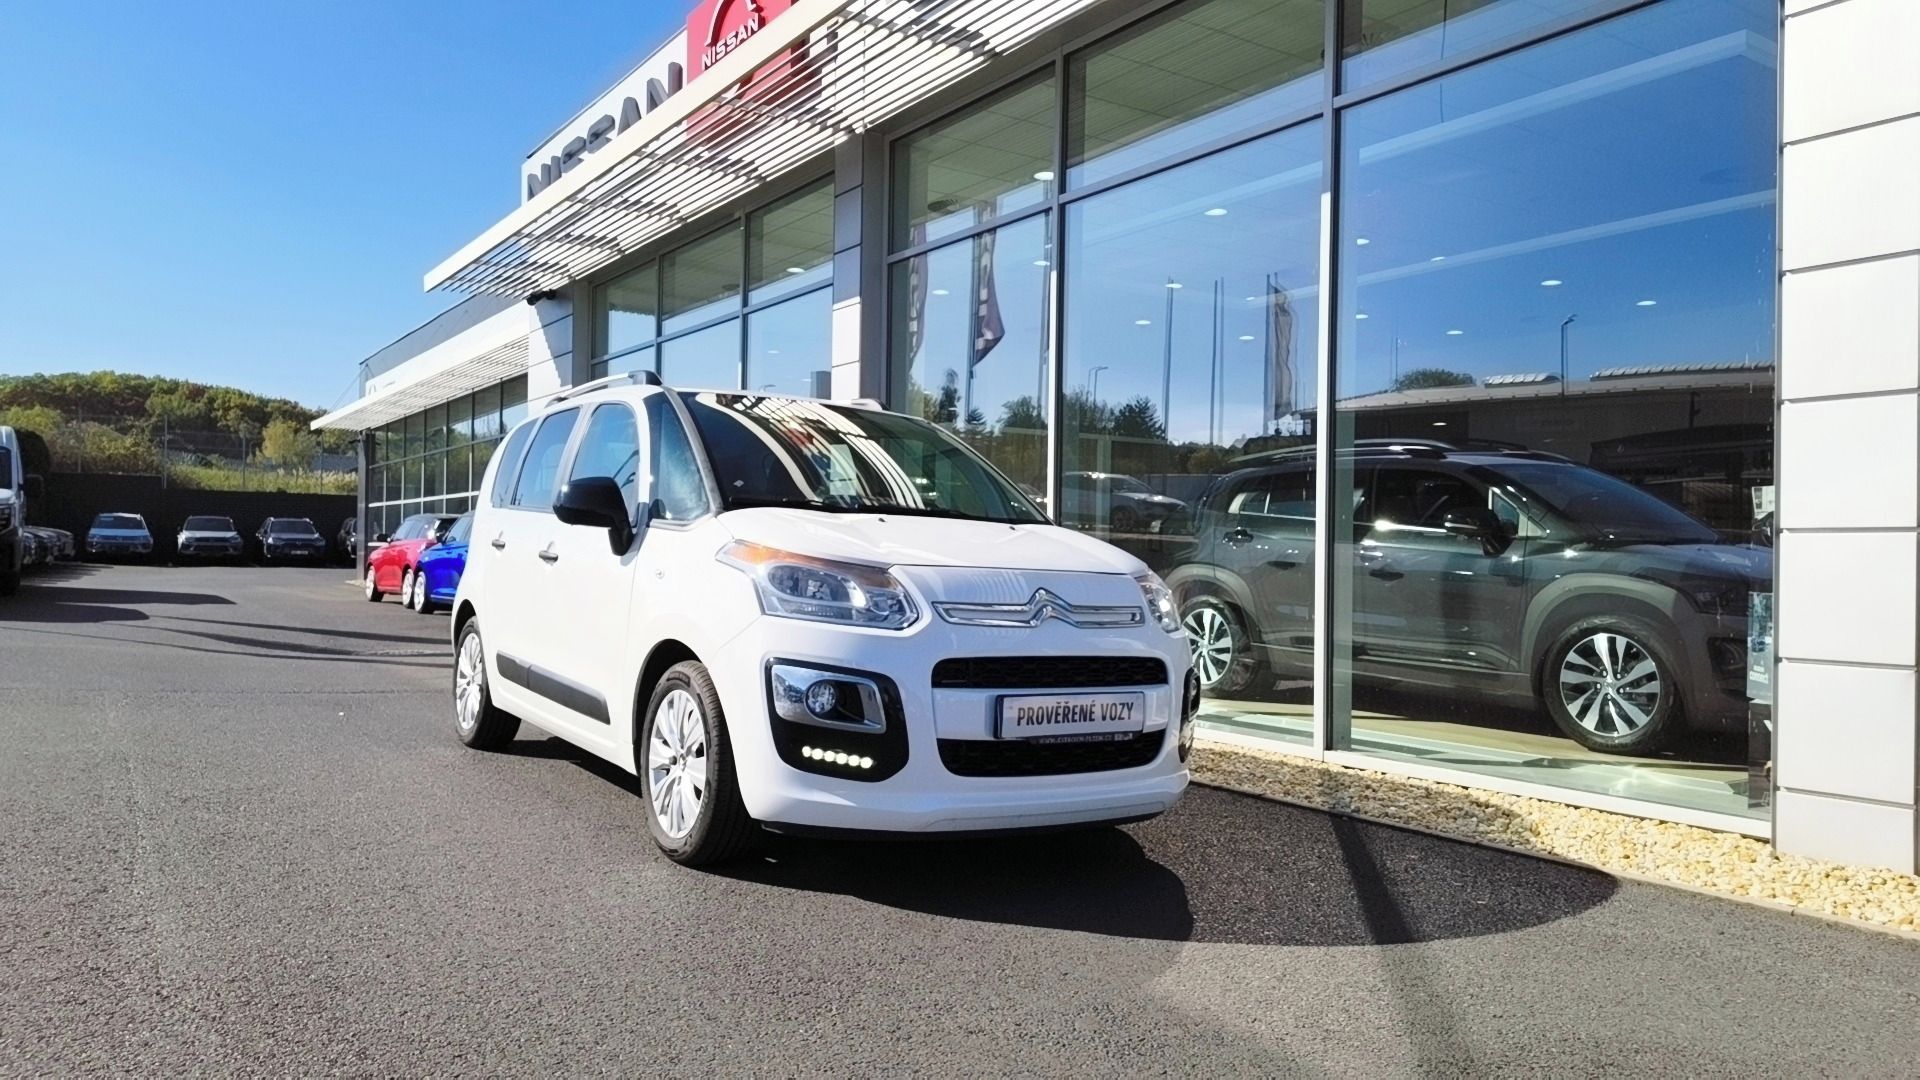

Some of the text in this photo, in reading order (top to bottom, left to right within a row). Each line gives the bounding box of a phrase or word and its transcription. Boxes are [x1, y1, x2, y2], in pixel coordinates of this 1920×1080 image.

[701, 13, 759, 71] NISSAN
[1016, 700, 1134, 726] PROVĚŘENÉ VOZY
